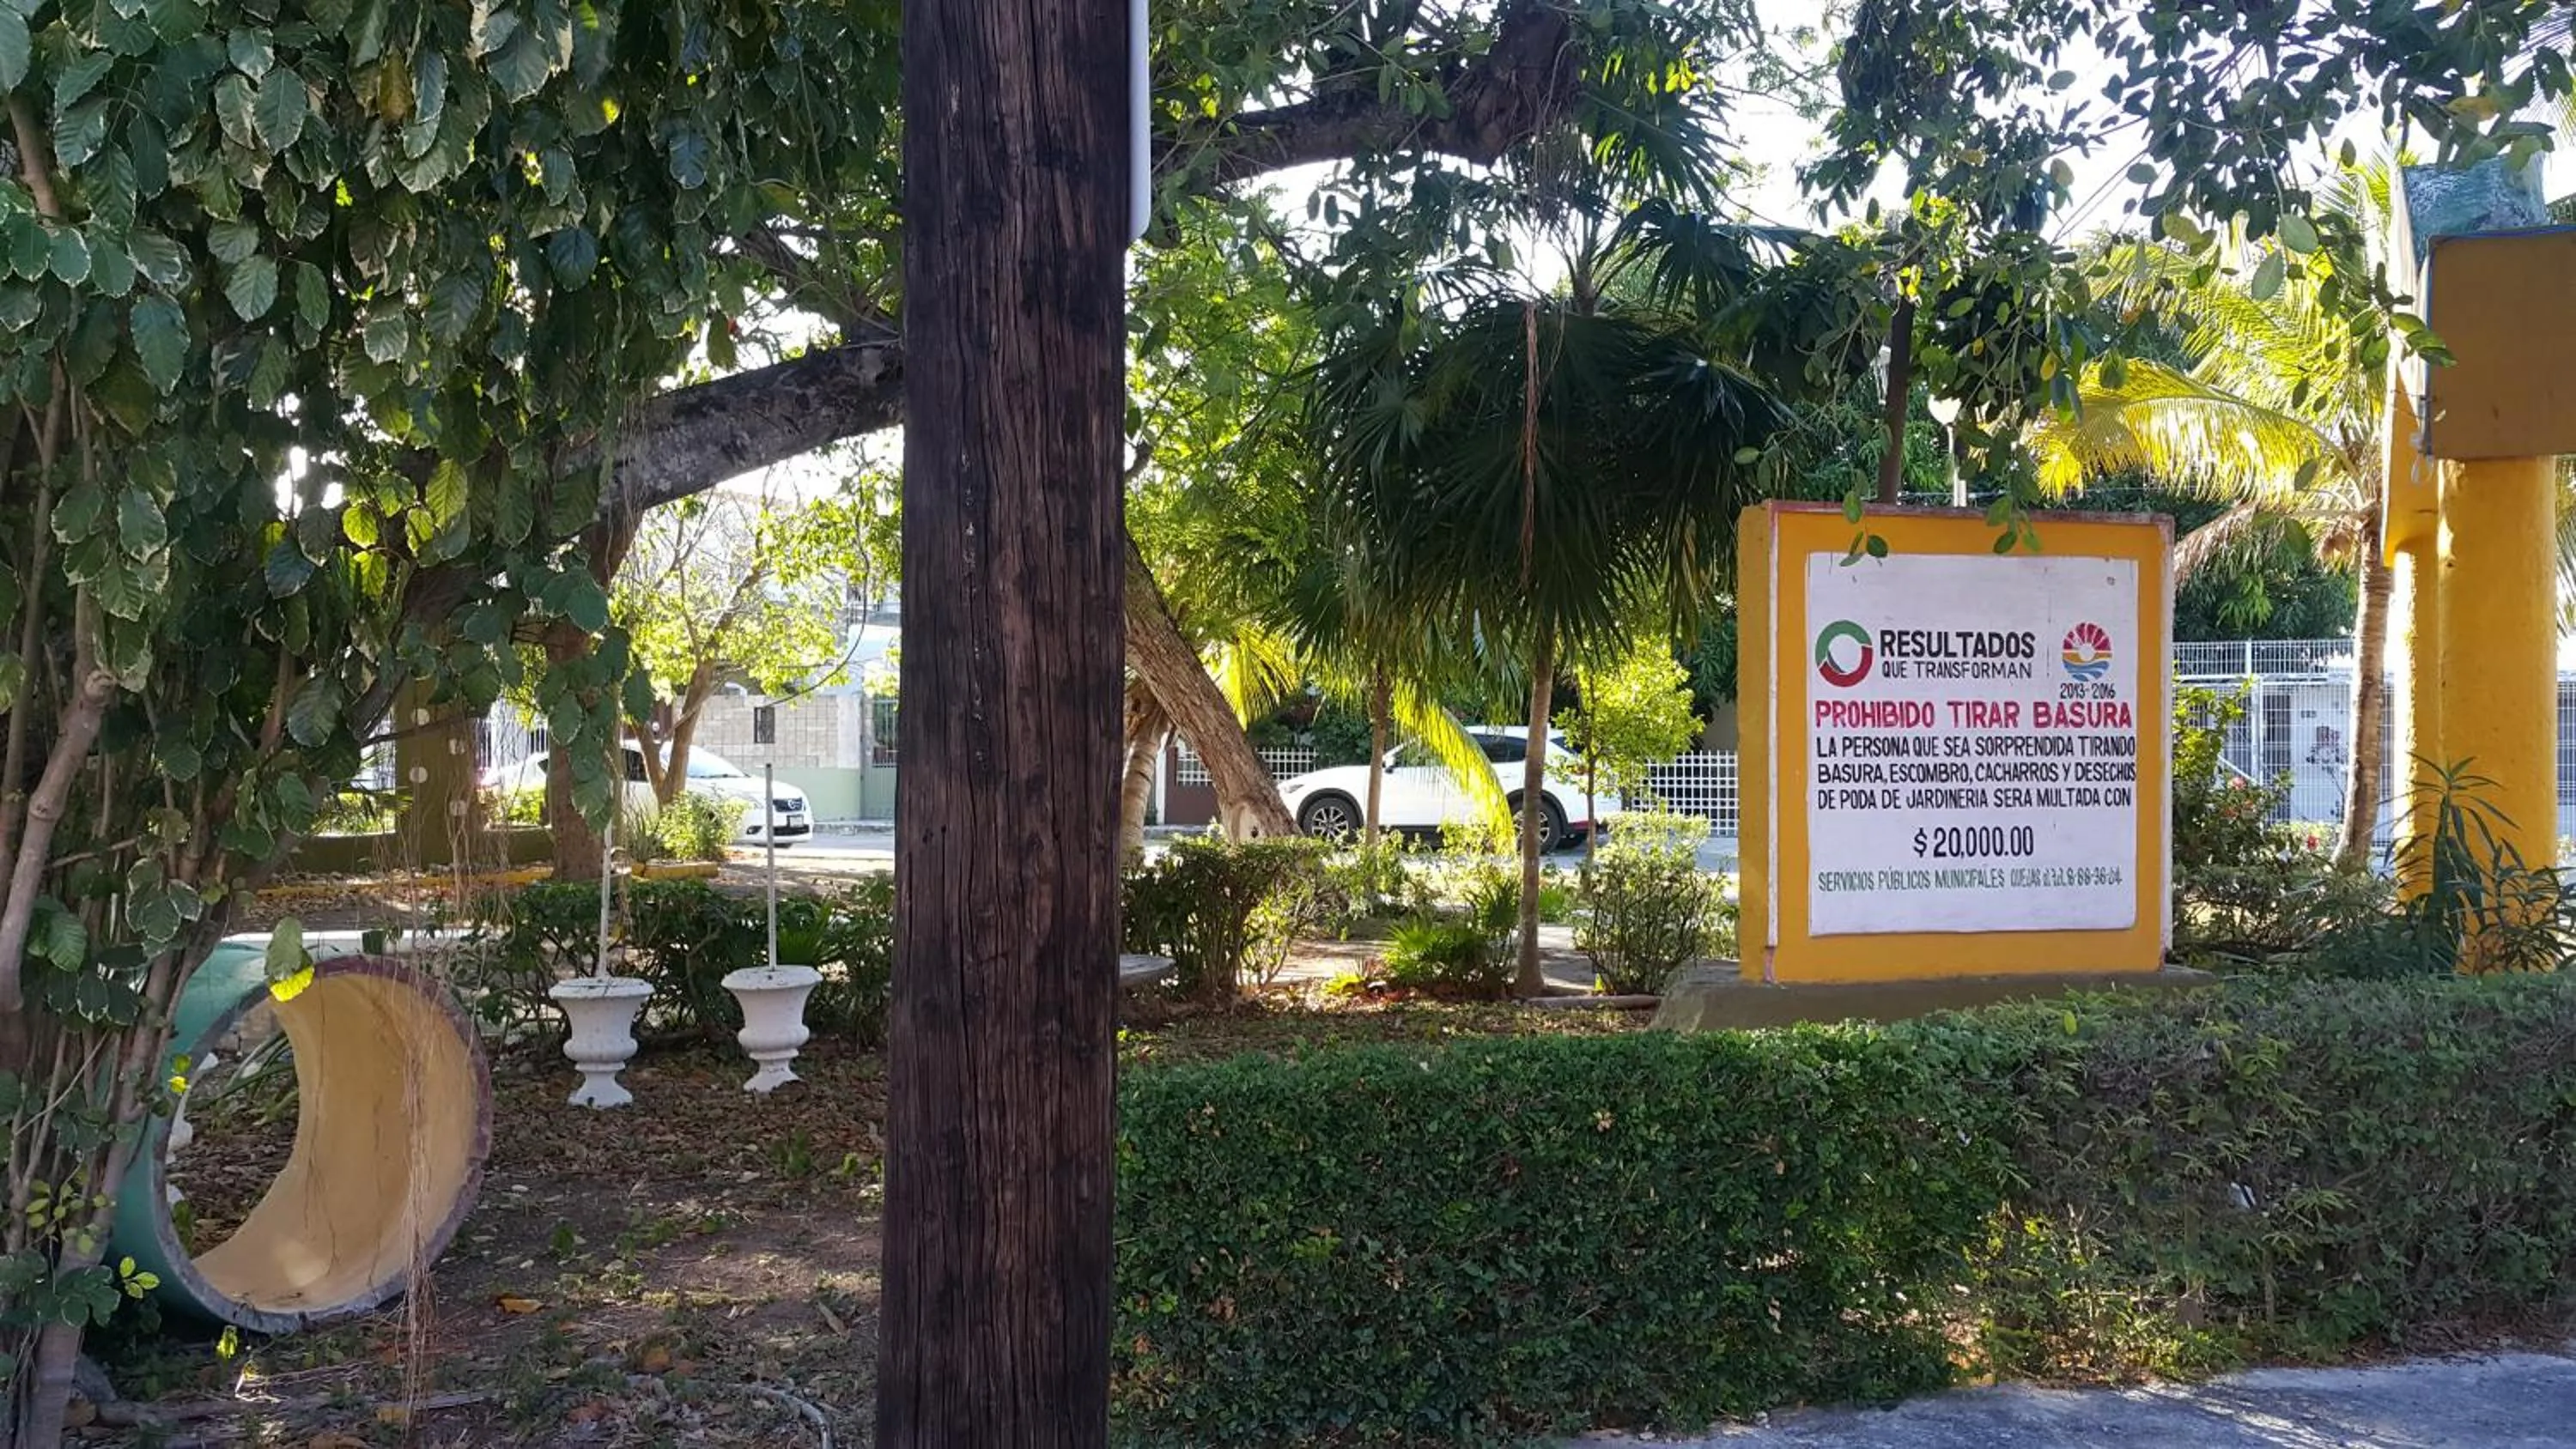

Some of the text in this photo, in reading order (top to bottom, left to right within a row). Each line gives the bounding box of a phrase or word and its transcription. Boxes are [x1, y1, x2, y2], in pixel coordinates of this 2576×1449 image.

[1880, 630, 2036, 658] RESULTADOS
[1882, 661, 2032, 679] QUE TRANSFORMAN
[1815, 700, 2132, 728] PROHIBIDO TIRAR BASURA
[1816, 736, 2136, 758] LA PERSONA QUE SEA SORPRENDIDA TIRANDO
[1818, 762, 2136, 785] BASURA, ESCOMBRO, CACHARROS Y DESECHOS
[1818, 788, 2132, 809] DE PODA DE JARDINERIA SERA MULTADA CON
[1933, 826, 2034, 859] 20,000.00
[1818, 870, 1874, 892] SERVICIOS
[1935, 868, 2005, 889] MUNICIPALES
